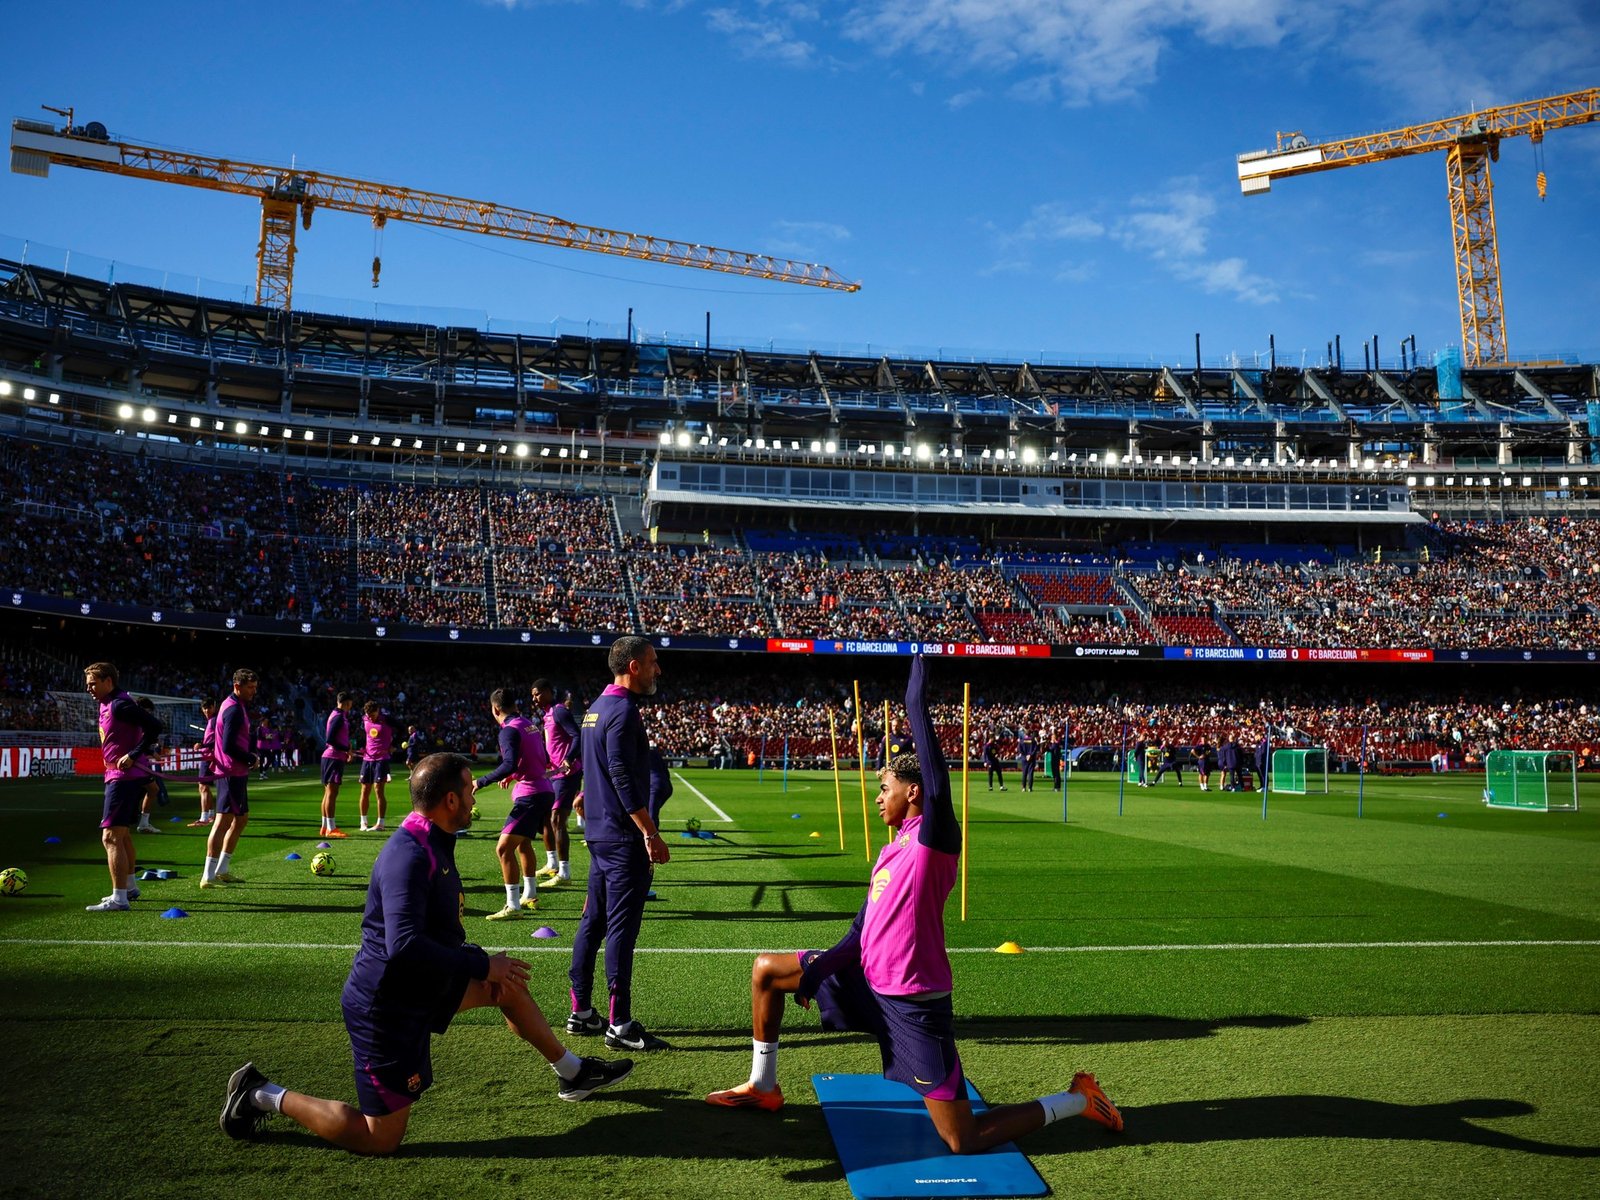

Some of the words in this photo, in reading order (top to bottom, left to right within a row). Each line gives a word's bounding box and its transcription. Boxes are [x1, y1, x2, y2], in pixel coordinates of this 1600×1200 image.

[781, 641, 808, 649] ESTRELLA
[846, 643, 856, 652] FC
[856, 643, 897, 653] BARCELONA
[910, 643, 918, 653] 0
[923, 643, 943, 653] 05:08
[947, 643, 955, 653] 0
[965, 644, 975, 654] FC
[975, 644, 1016, 655] BARCELONA
[1084, 648, 1108, 656] SPOTIFY
[1195, 647, 1204, 658] FC
[1205, 647, 1244, 659] BARCELONA
[1256, 649, 1264, 659] 0
[1268, 649, 1287, 659] 05:08
[1291, 649, 1299, 660] 0
[1308, 650, 1318, 660] FC
[1318, 650, 1357, 660] BARCELONA
